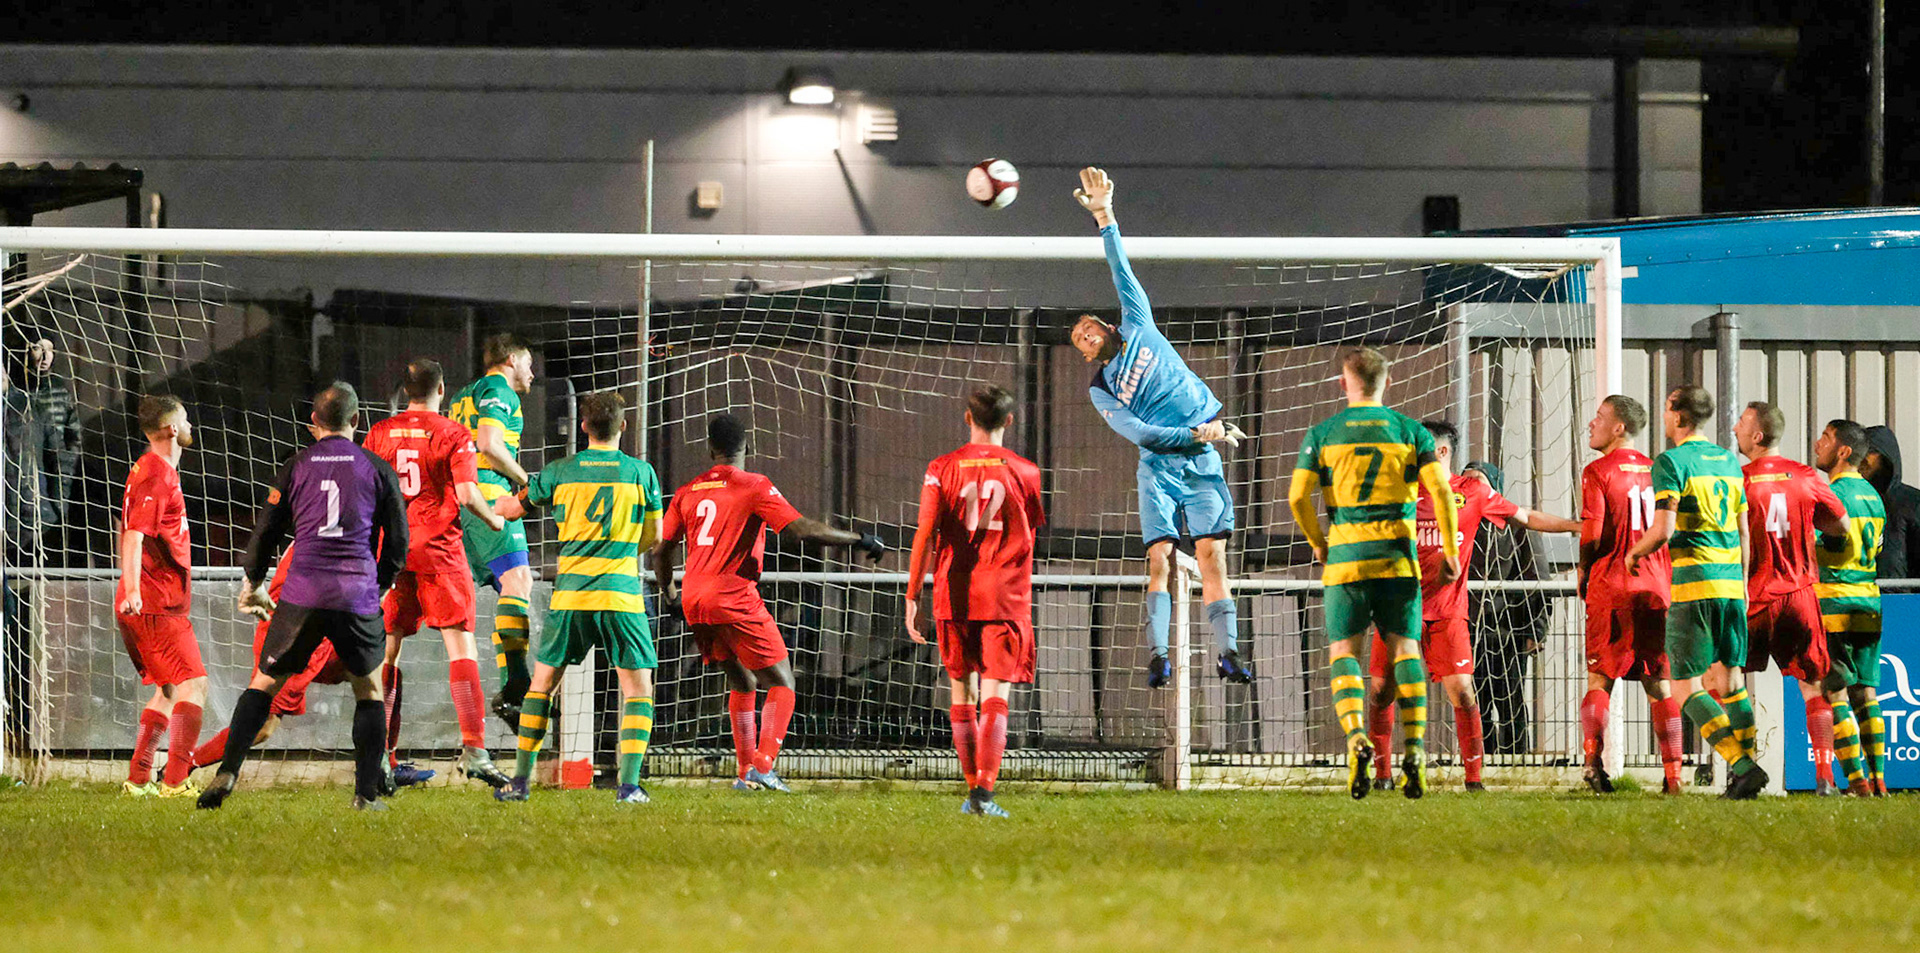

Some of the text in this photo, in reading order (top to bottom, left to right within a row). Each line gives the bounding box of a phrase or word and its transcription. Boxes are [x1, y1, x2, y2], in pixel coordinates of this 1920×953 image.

[395, 448, 422, 496] 5
[1354, 446, 1385, 503] 7
[317, 479, 344, 538] 1
[584, 485, 615, 538] 4
[695, 498, 717, 547] 2
[959, 479, 1006, 532] 12
[1627, 484, 1656, 532] 11
[1712, 478, 1730, 529] 3
[1765, 492, 1791, 540] 4
